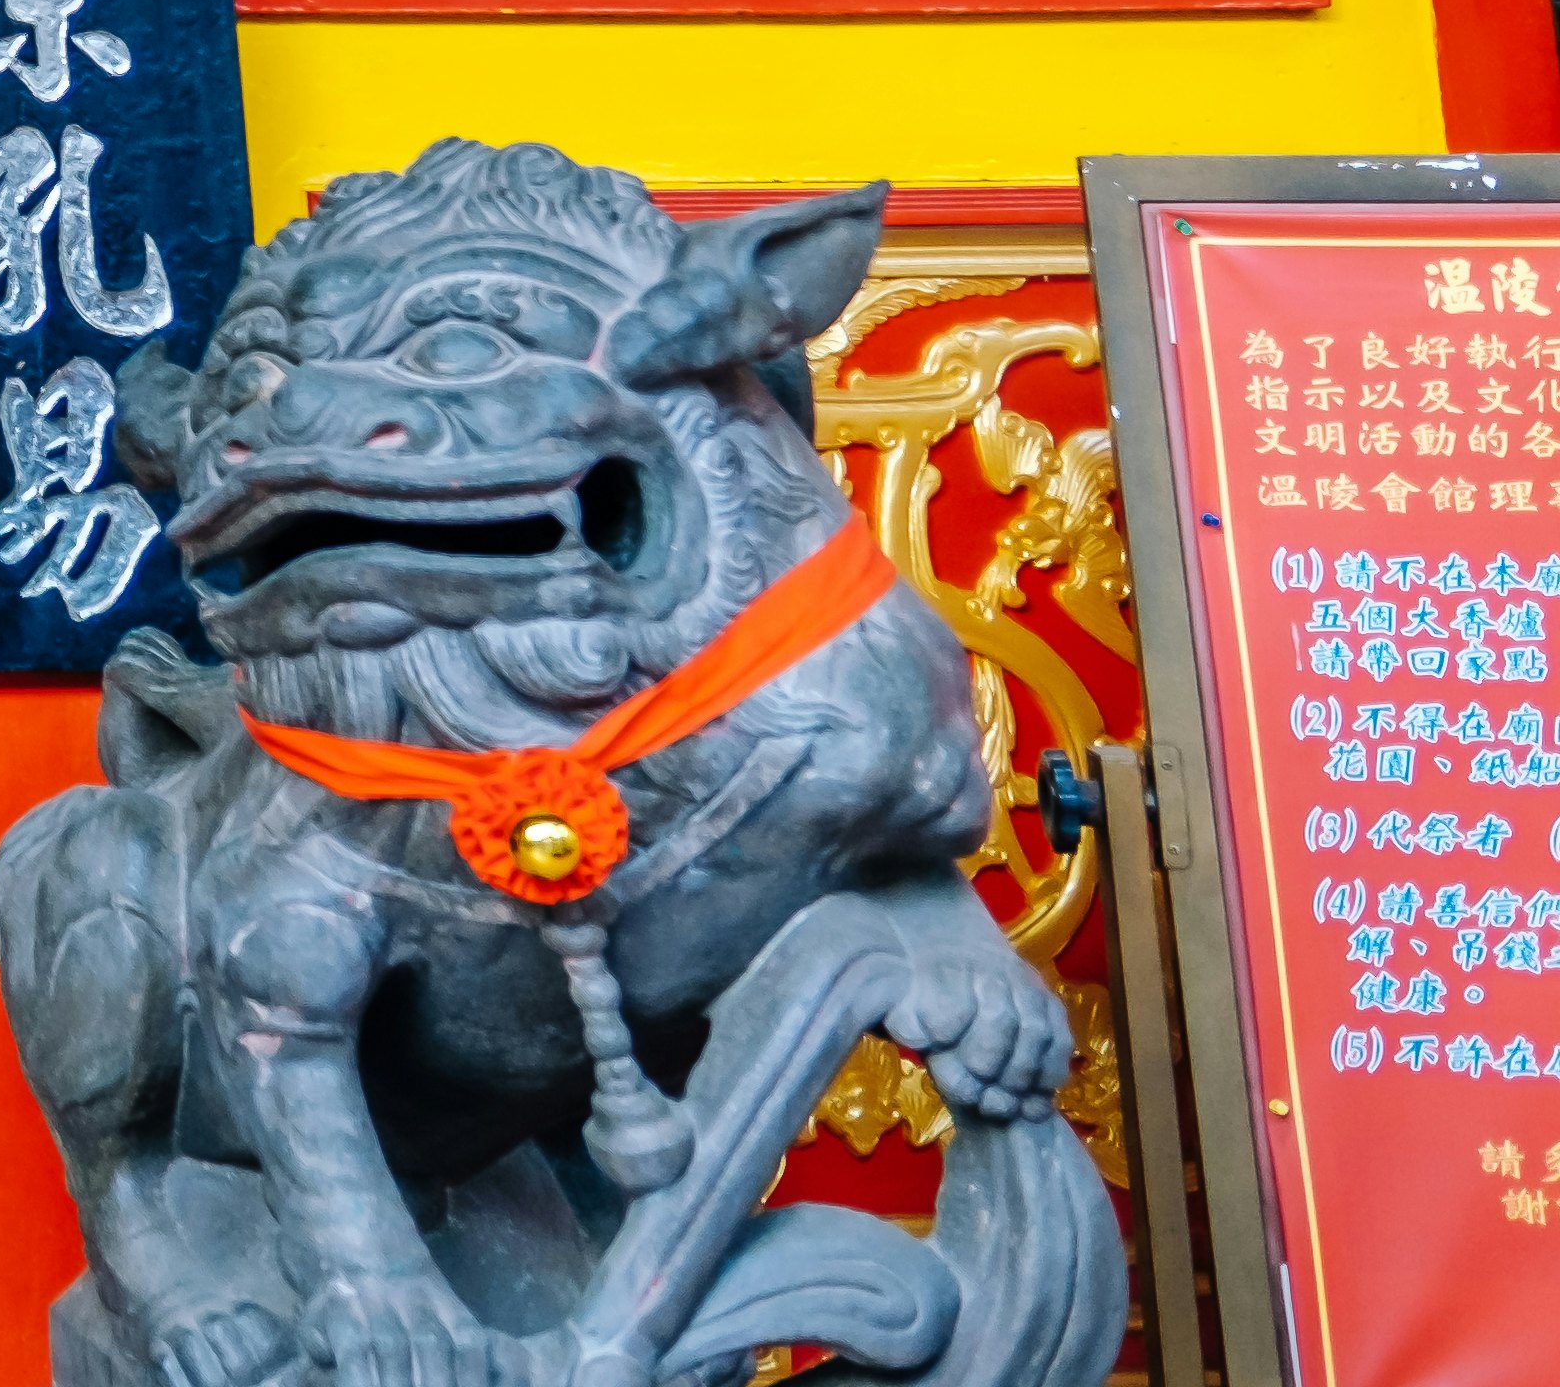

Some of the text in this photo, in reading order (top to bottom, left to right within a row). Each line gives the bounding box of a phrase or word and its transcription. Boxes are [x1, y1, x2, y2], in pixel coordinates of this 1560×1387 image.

[1244, 375, 1560, 415] 指示以及文化
[1254, 421, 1560, 458] 文明活動的各
[1305, 599, 1545, 641] 五個大香爐
[1308, 638, 1548, 682] 請帶回家點
[1290, 694, 1560, 745] (2)不得在廟
[1502, 1189, 1560, 1228] 謝
